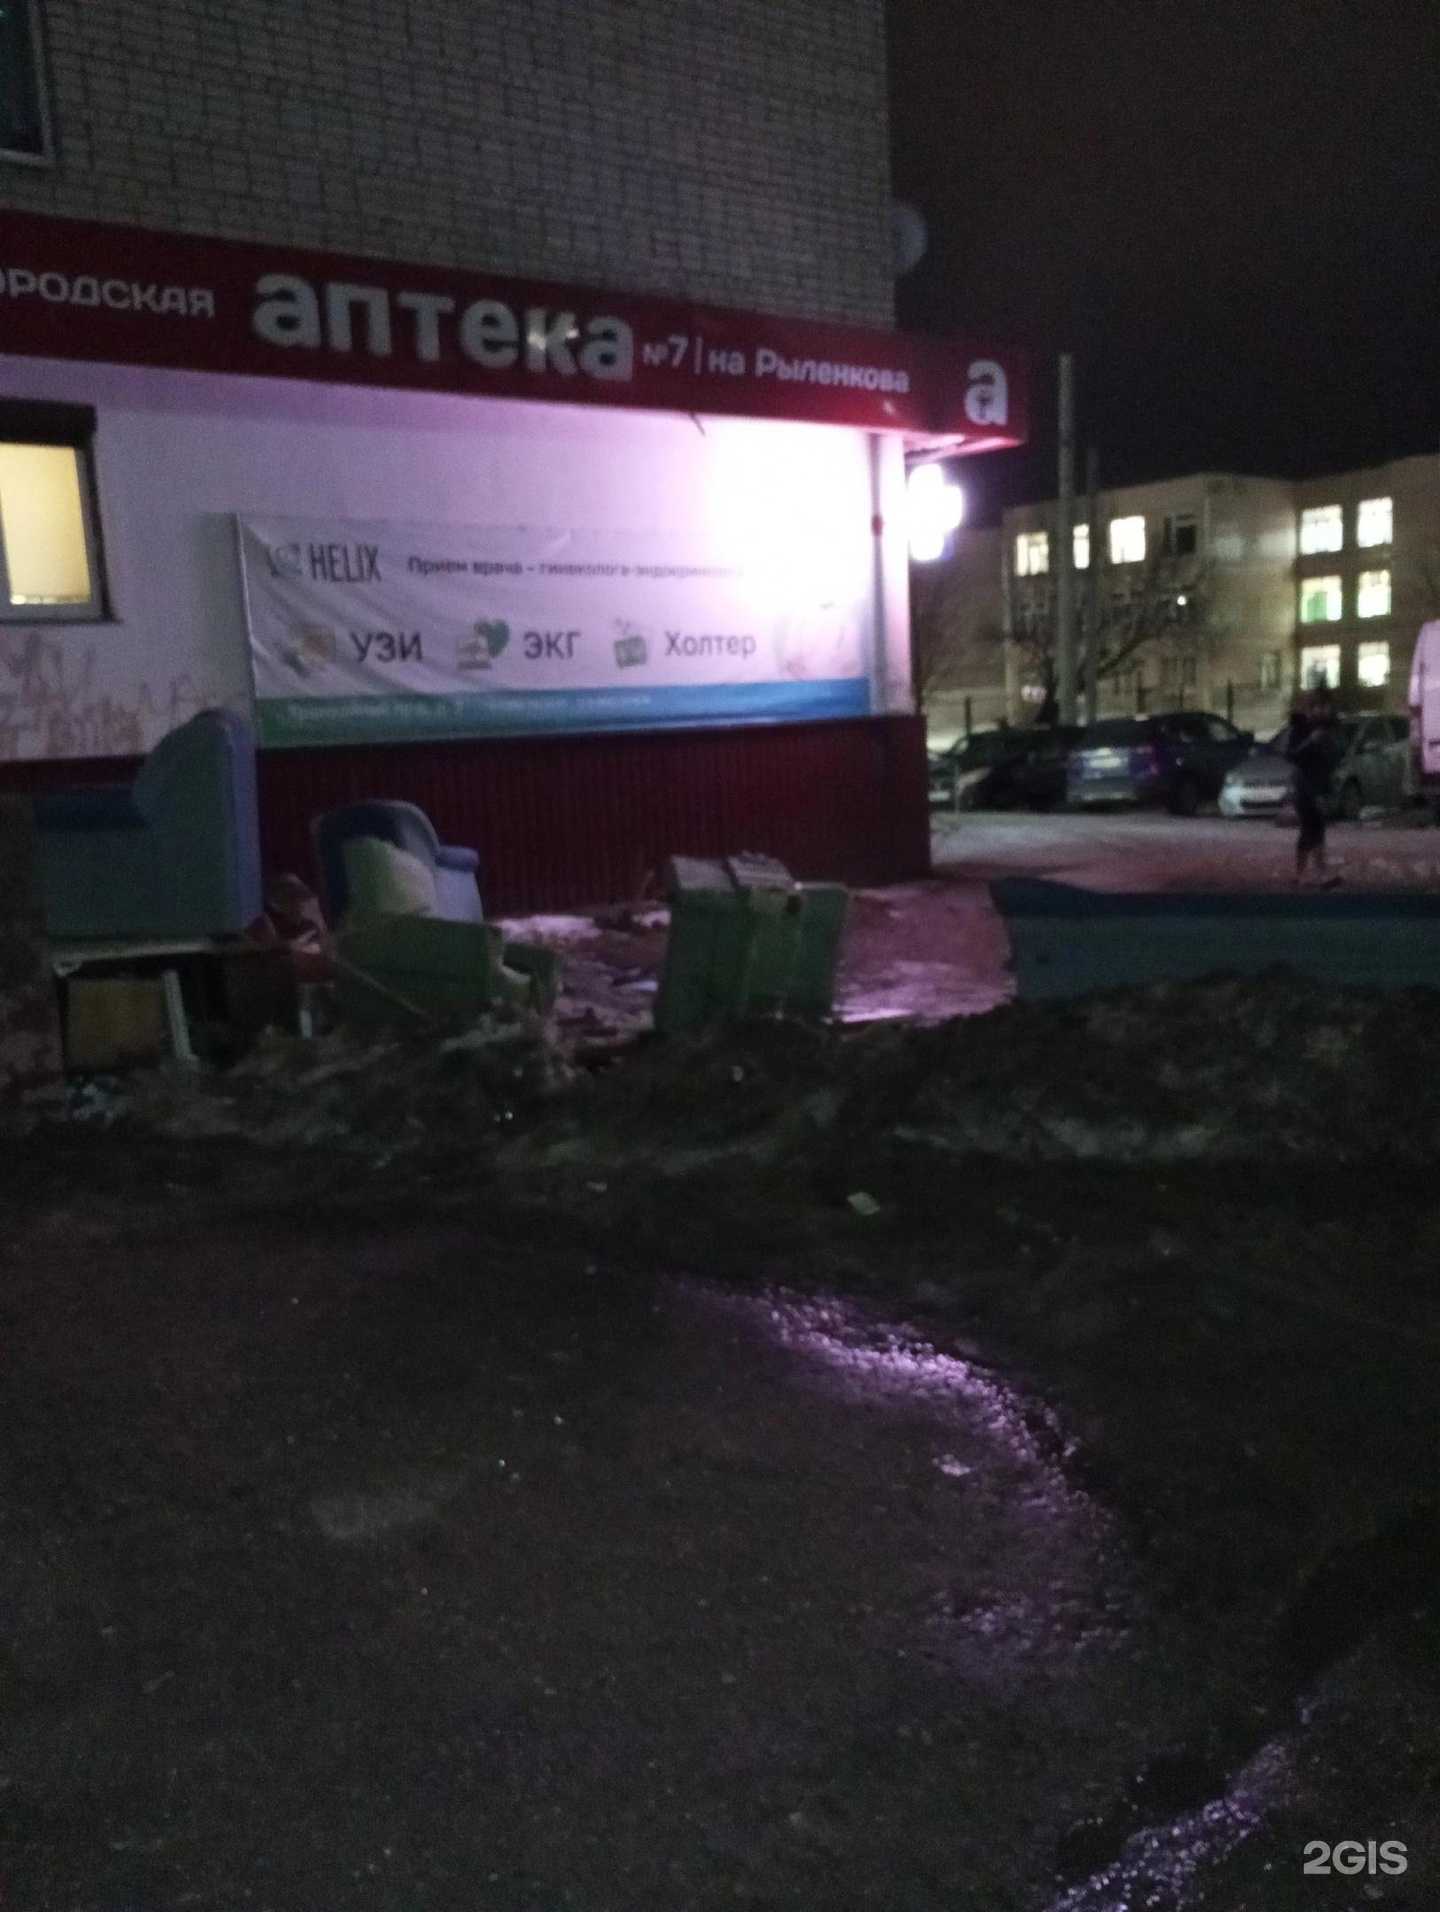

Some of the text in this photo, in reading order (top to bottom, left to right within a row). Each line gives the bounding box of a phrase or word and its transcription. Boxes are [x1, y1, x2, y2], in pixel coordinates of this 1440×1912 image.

[0, 267, 911, 394] РОДСКАЯ аптека №7 на Рыленкова
[310, 543, 381, 583] HELIX
[351, 632, 423, 662] УЗИ
[524, 633, 581, 658] ЭКГ
[664, 630, 757, 660] Холтер
